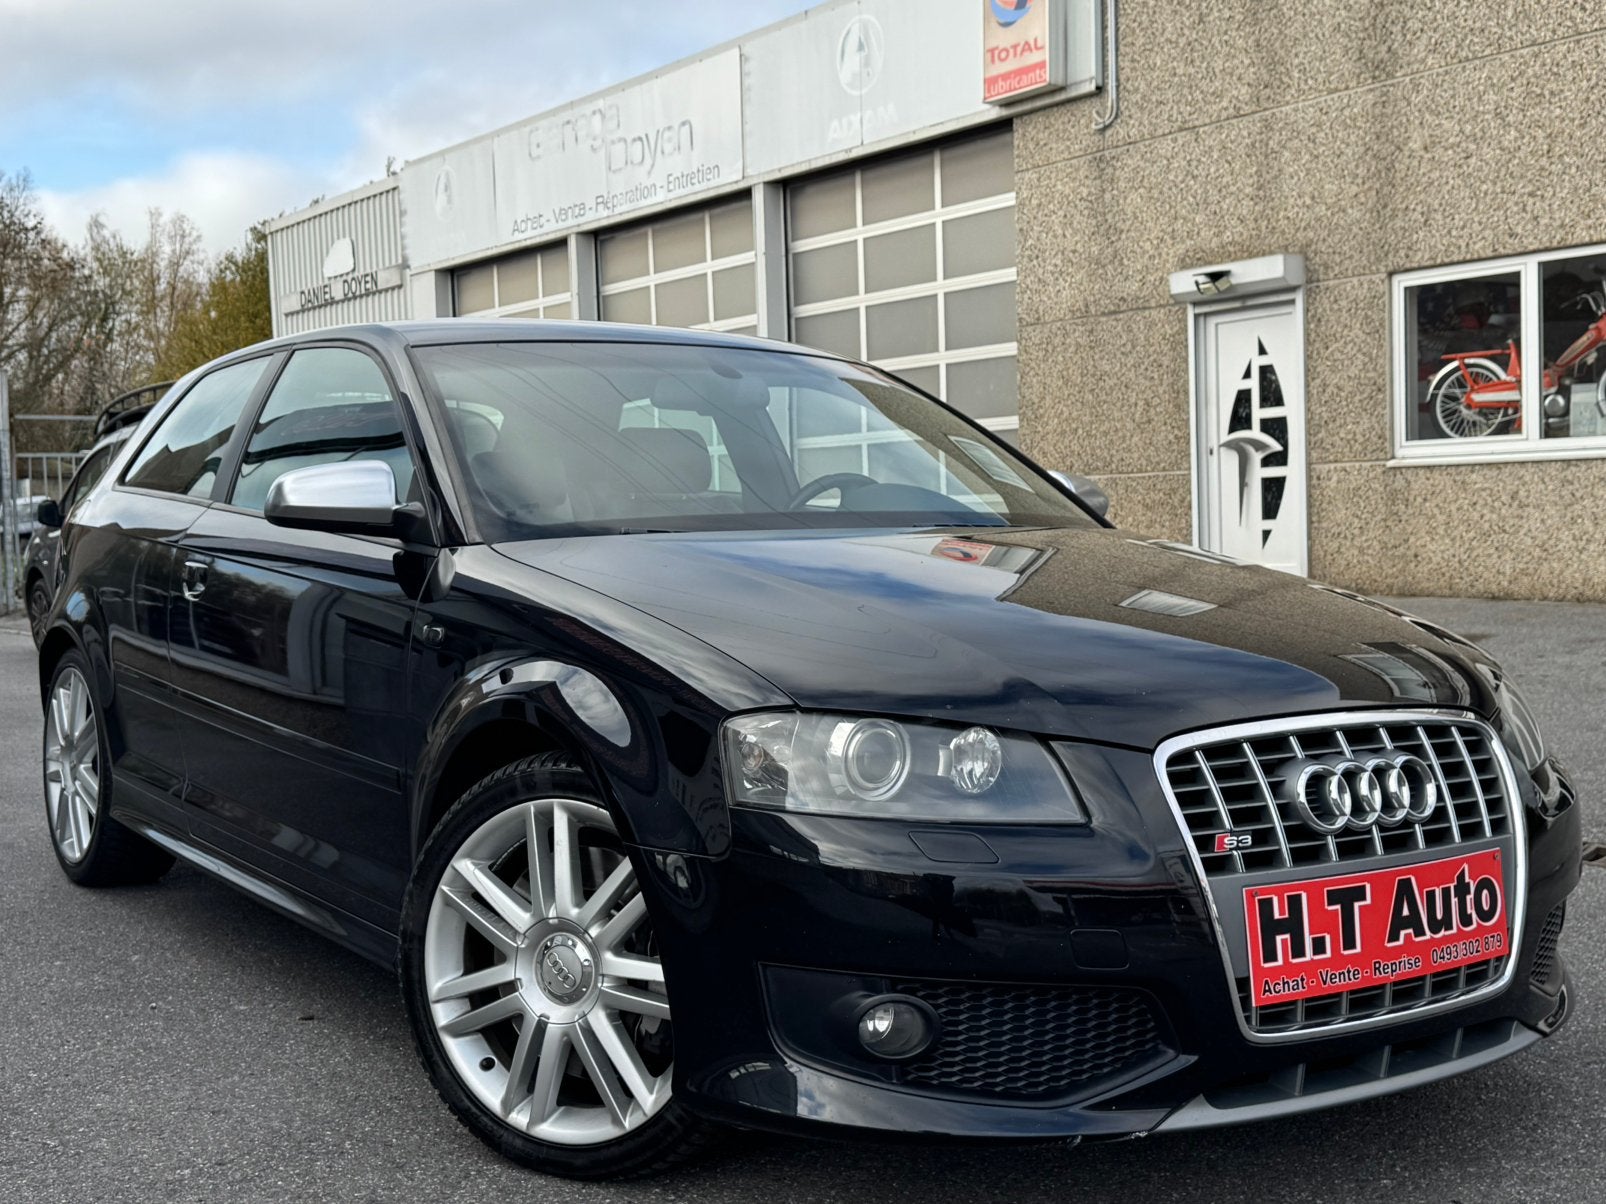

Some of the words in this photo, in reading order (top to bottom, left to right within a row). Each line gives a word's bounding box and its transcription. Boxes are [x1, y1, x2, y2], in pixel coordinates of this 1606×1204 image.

[986, 37, 1045, 65] TOTAL
[985, 68, 1047, 98] Lubricants
[511, 214, 545, 236] Achat
[595, 181, 657, 214] Réparation
[667, 164, 721, 193] Entretien
[300, 283, 335, 308] DANIEL
[342, 271, 379, 298] DOYEN
[1223, 835, 1253, 848] S3
[1255, 882, 1371, 968] H.T
[1384, 862, 1502, 947] Auto
[1261, 975, 1307, 997] Achat
[1318, 967, 1361, 987] Vente
[1373, 956, 1421, 979] Reprise
